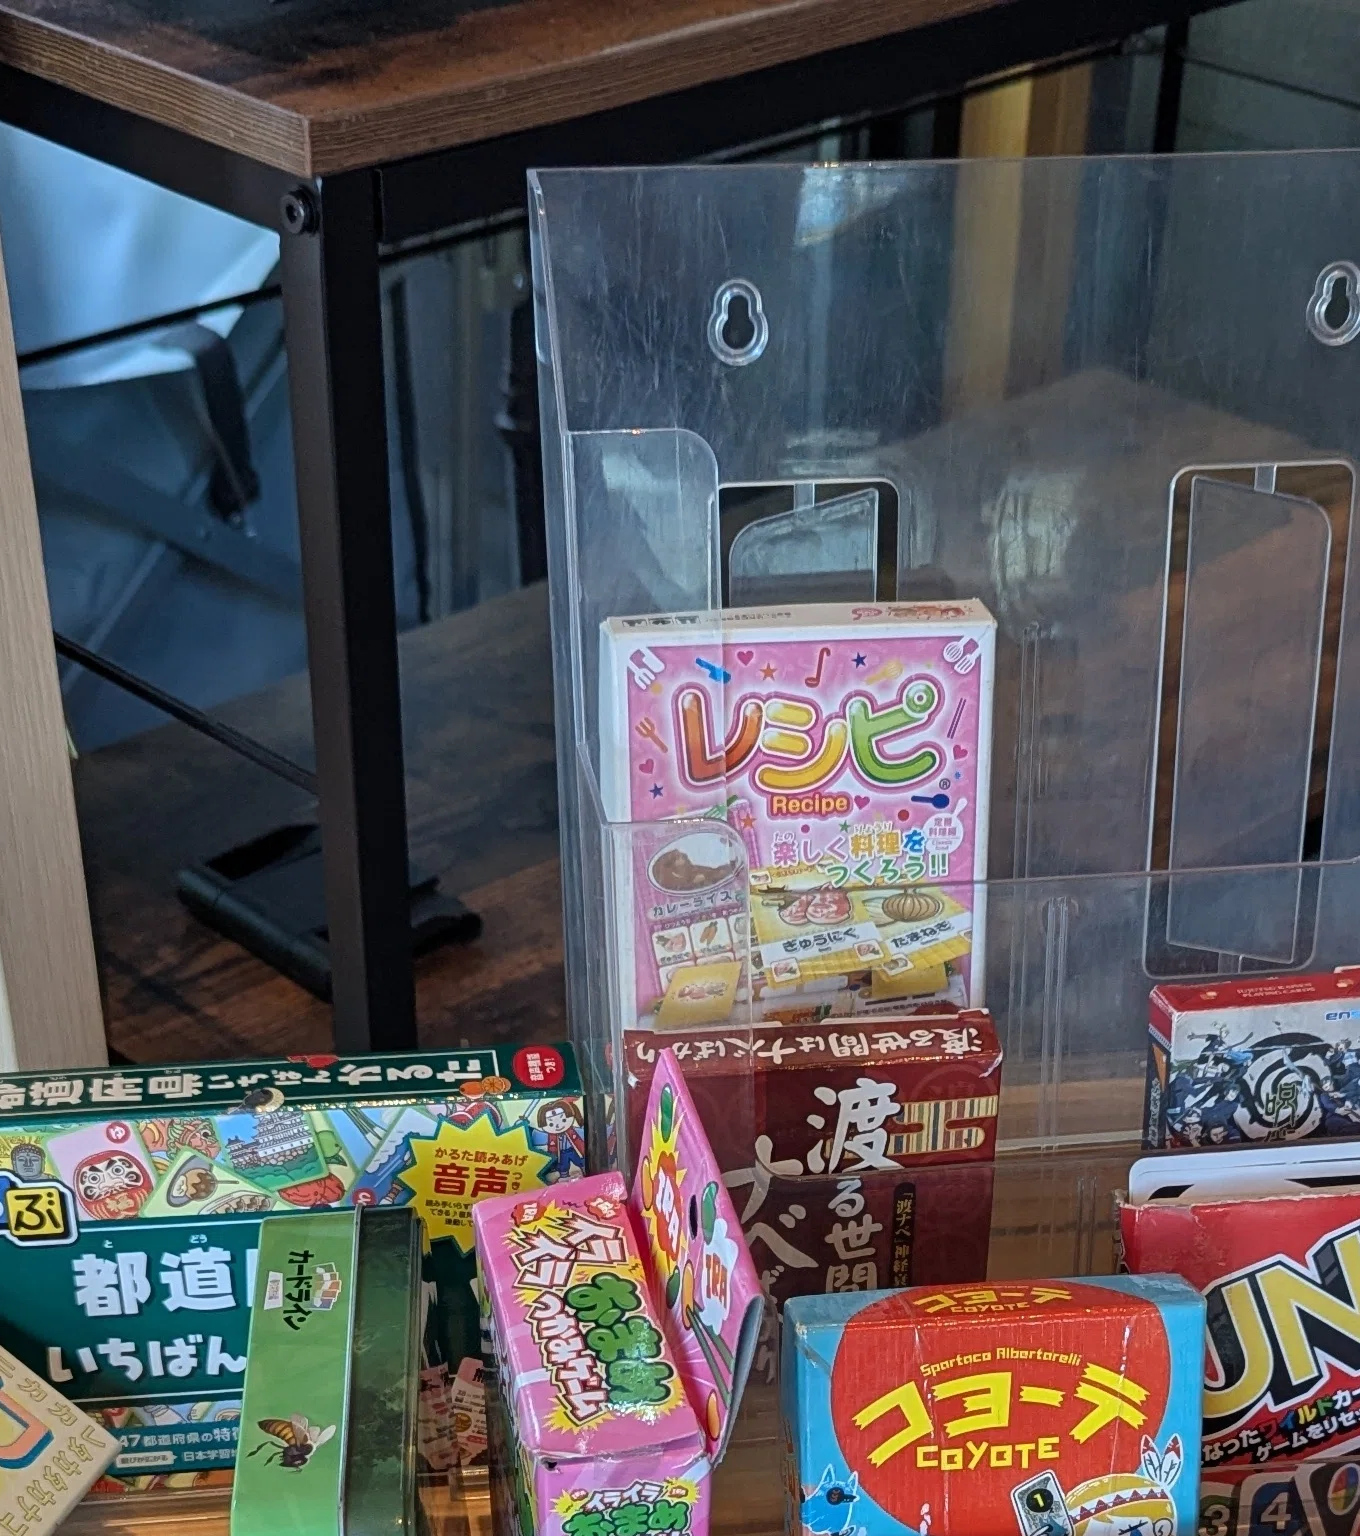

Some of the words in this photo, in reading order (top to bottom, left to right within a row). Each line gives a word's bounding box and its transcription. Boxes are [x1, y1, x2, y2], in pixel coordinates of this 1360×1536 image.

[676, 680, 942, 790] レシピ
[772, 795, 849, 817] Recipe
[782, 926, 861, 953] ぎゅうにく
[434, 1147, 529, 1167] かるた読みあげ
[433, 1163, 511, 1198] 音声
[103, 1239, 114, 1250] と
[72, 1245, 261, 1319] 都道
[283, 1250, 315, 1331] カードライン
[705, 1253, 729, 1308] IRA
[912, 1286, 1073, 1314] コヨーテ
[951, 1302, 1031, 1314] COYOTE
[565, 1272, 675, 1405] おまめ
[47, 1334, 247, 1385] いちばん
[920, 1350, 992, 1377] Spartaco
[996, 1347, 1083, 1367] Albertarelli
[851, 1362, 1151, 1468] コヨーテ
[916, 1436, 1061, 1471] COYOTE
[587, 1484, 665, 1512] イライラ
[1032, 1492, 1045, 1508] 1
[1260, 1492, 1292, 1531] 4
